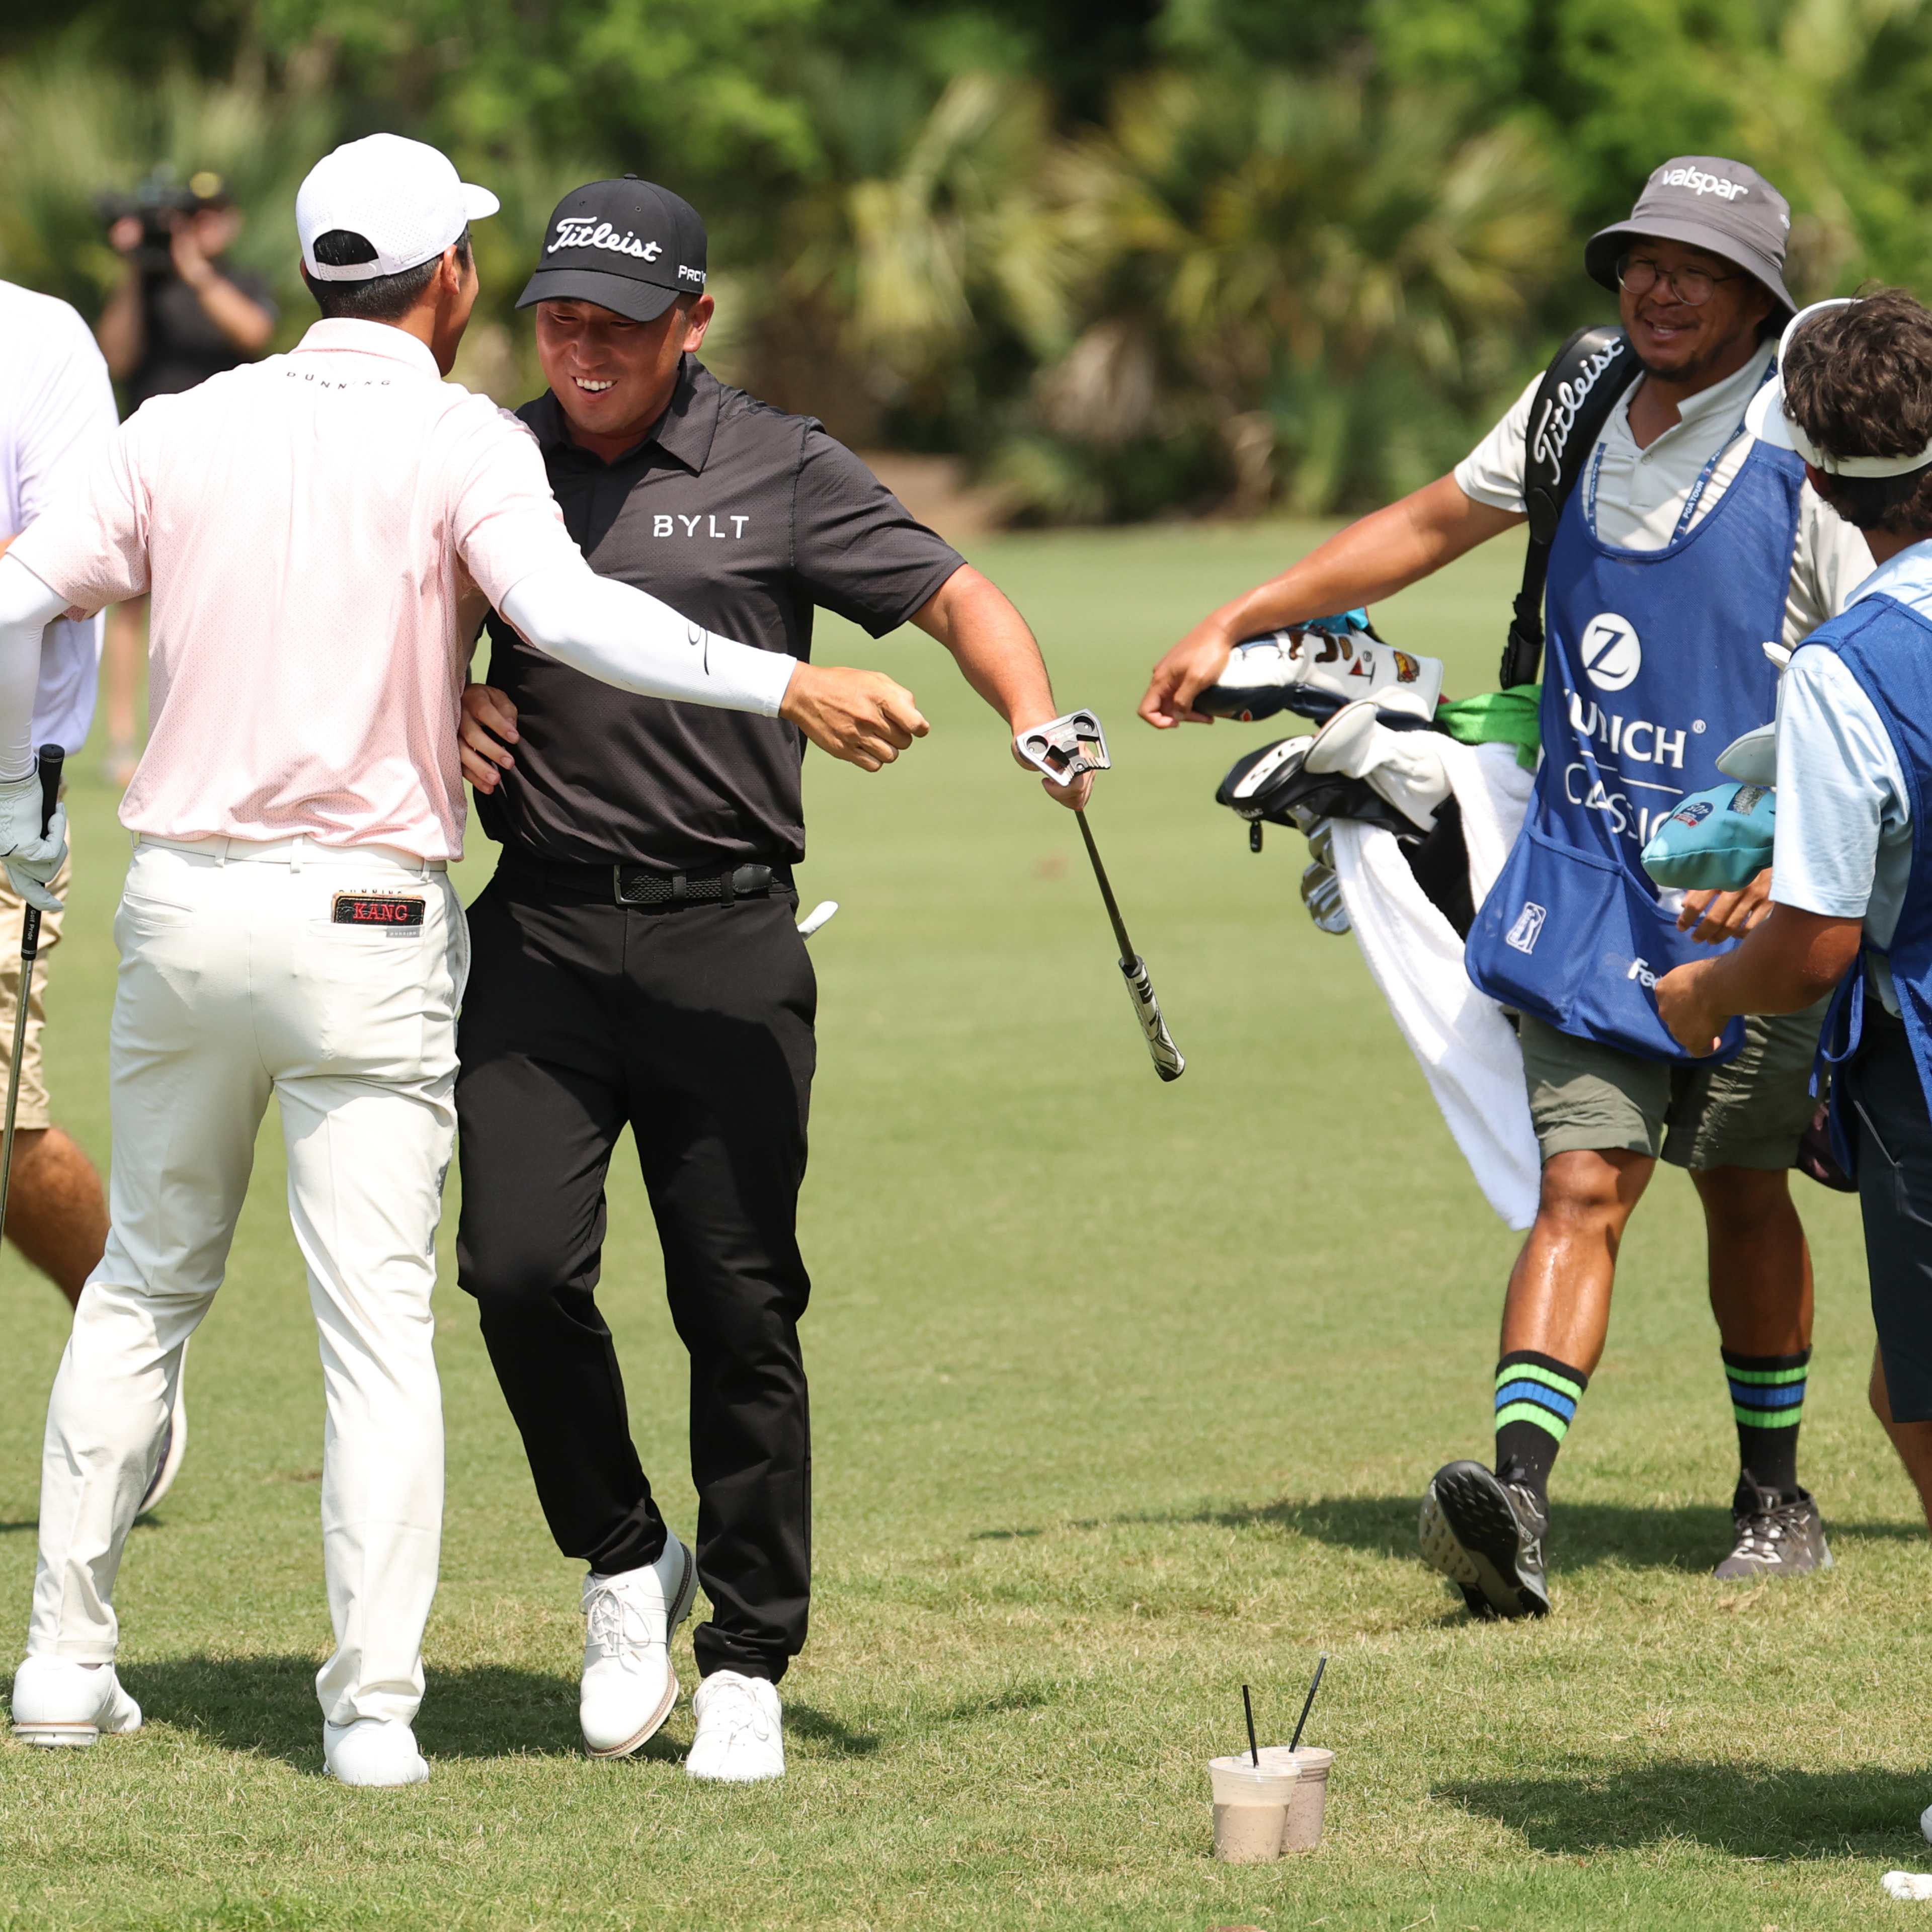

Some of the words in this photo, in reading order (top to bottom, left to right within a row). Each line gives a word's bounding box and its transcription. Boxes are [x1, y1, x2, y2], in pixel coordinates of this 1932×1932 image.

[1662, 166, 1745, 200] valspar
[547, 216, 662, 262] Titleist
[286, 371, 391, 389] DUNNNG
[1534, 336, 1625, 486] Titleist
[1683, 503, 1695, 519] PGA
[1690, 480, 1705, 502] TOUR
[653, 515, 750, 539] BYLT
[1563, 688, 1686, 769] UICH
[353, 902, 409, 922] KANG
[27, 924, 35, 941] Pride
